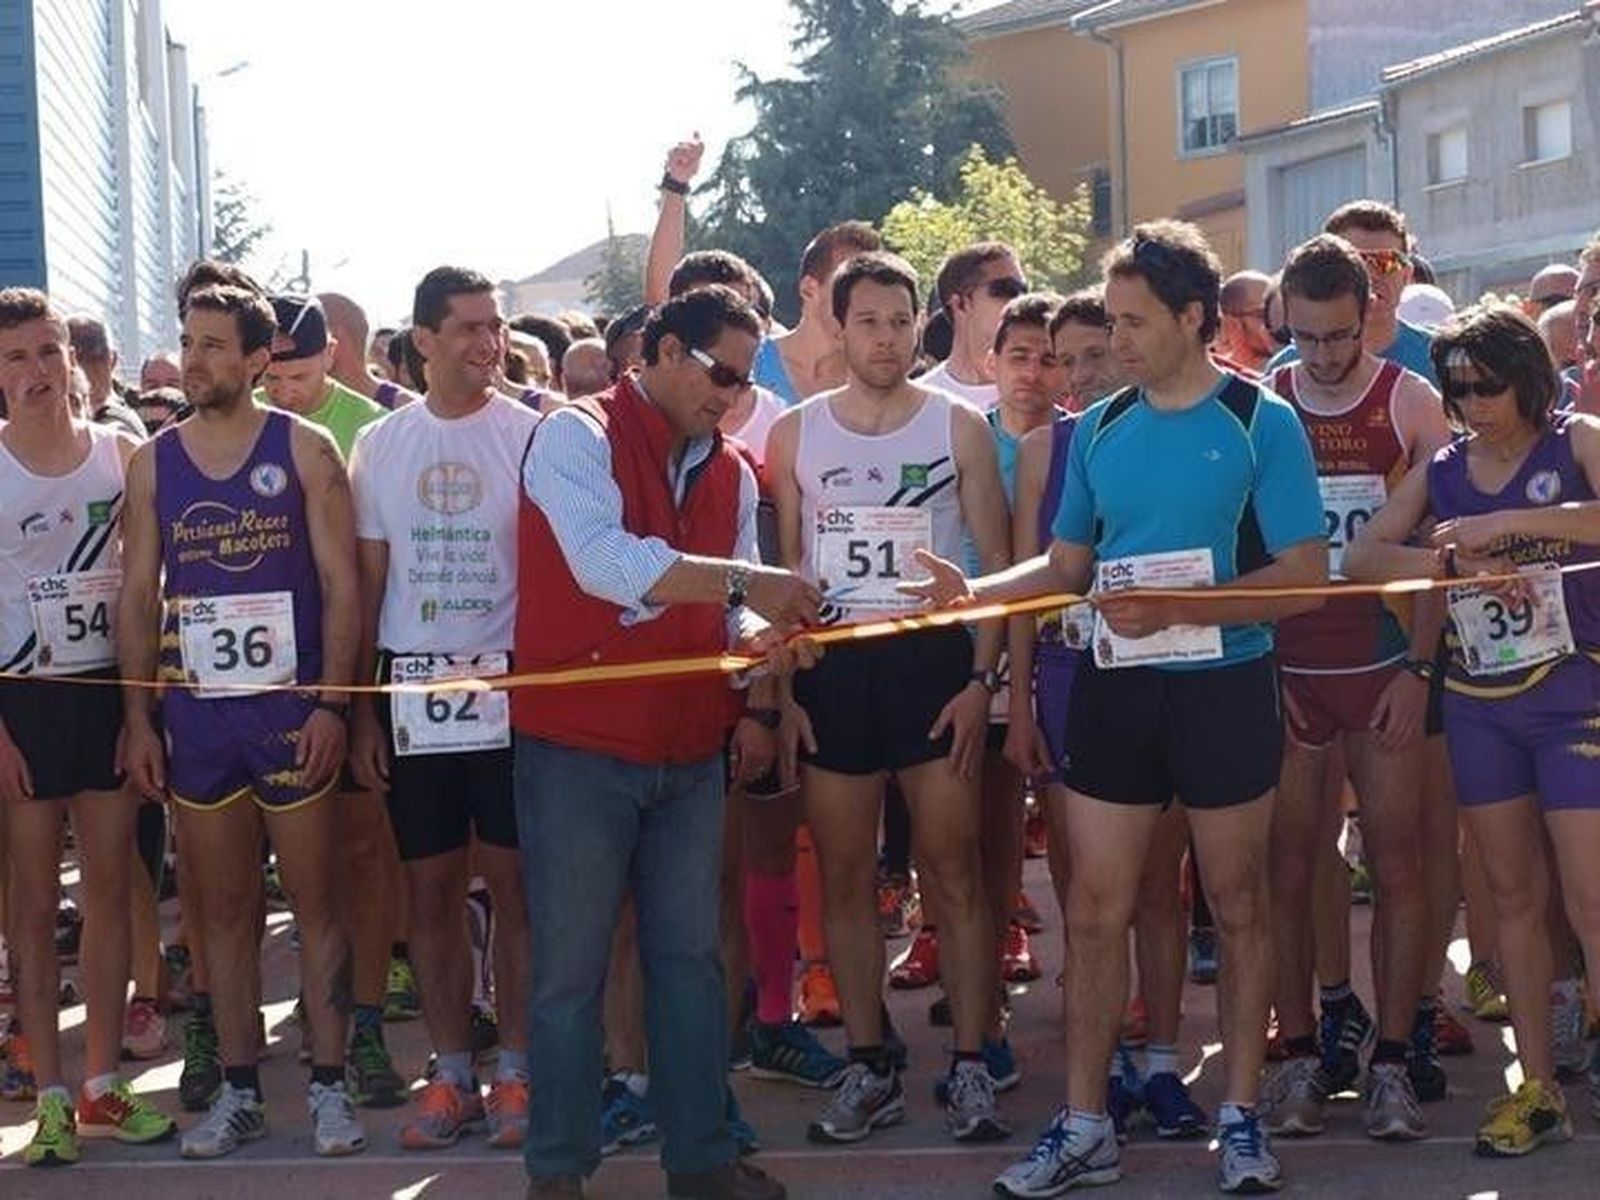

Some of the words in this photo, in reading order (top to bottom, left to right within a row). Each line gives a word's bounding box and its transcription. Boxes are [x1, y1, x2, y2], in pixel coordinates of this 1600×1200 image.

[828, 509, 854, 525] chc
[846, 539, 900, 579] 51
[40, 578, 69, 592] chc
[64, 601, 110, 642] 54
[1483, 600, 1534, 641] 39
[211, 624, 272, 670] 36
[425, 692, 480, 723] 62
